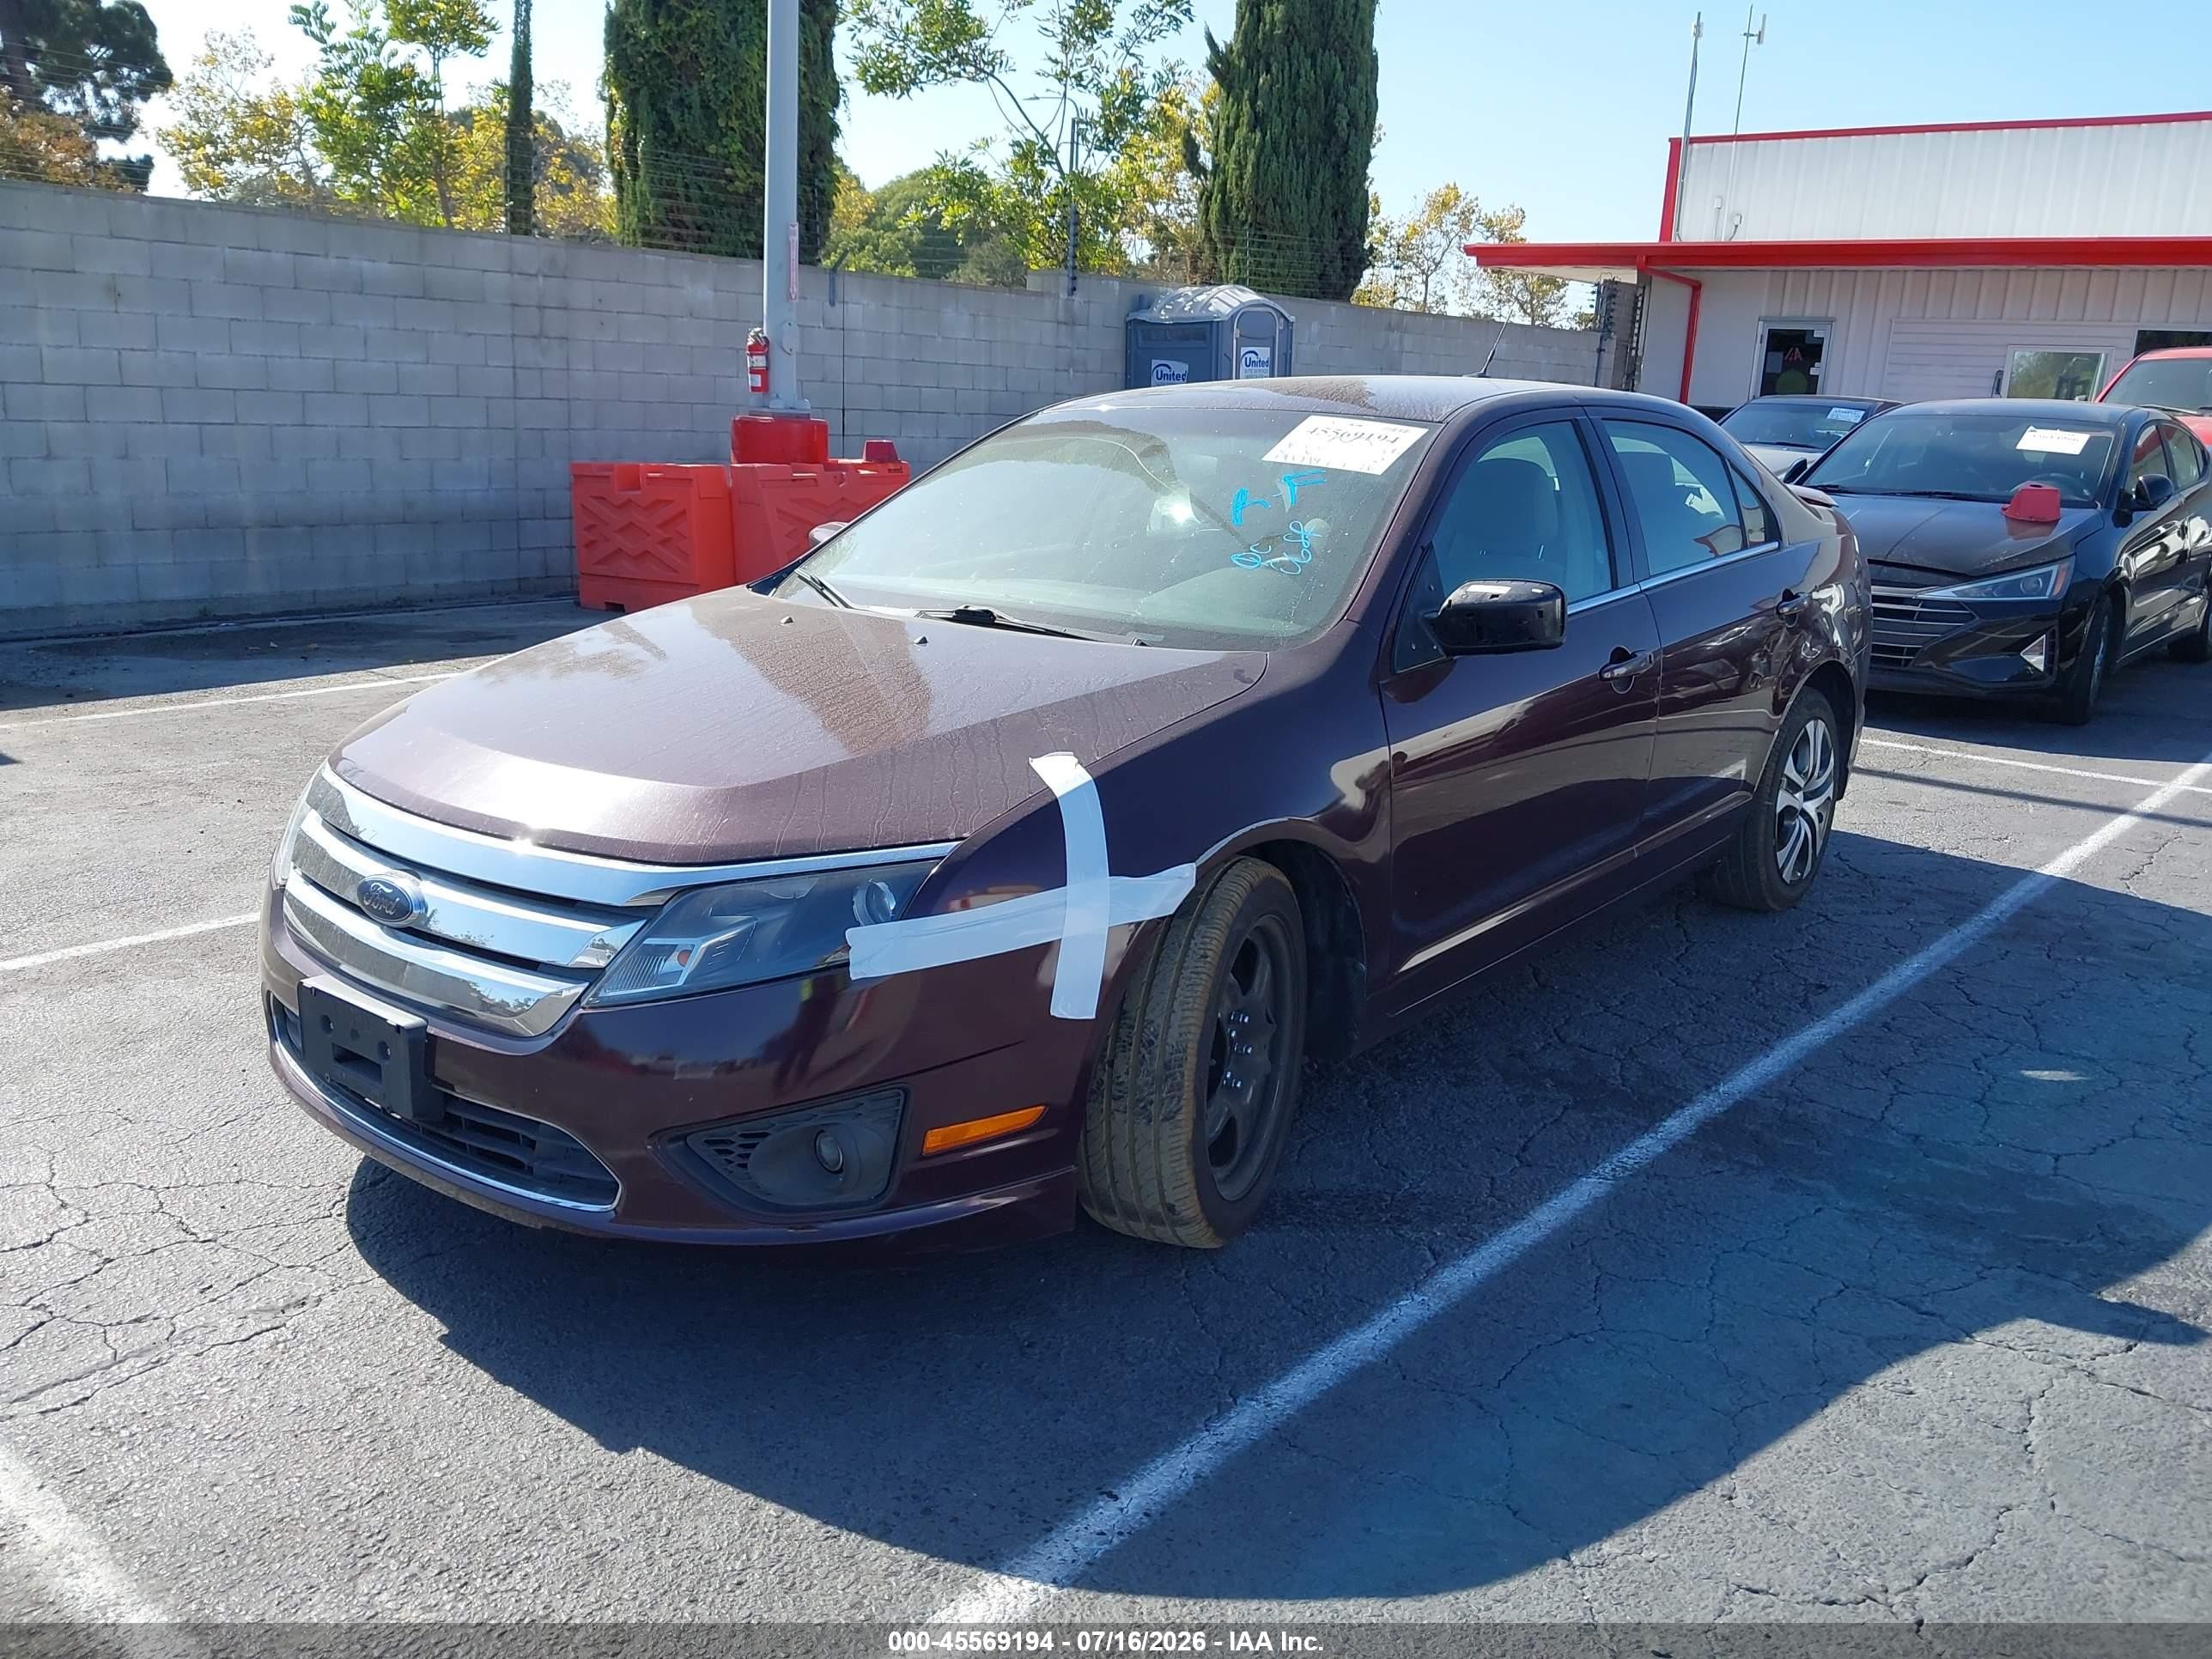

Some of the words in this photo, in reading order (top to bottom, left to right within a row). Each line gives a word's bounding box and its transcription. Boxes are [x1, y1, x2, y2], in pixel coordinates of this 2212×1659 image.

[1244, 356, 1269, 368] United
[1156, 369, 1187, 381] United
[363, 882, 400, 915] Ford
